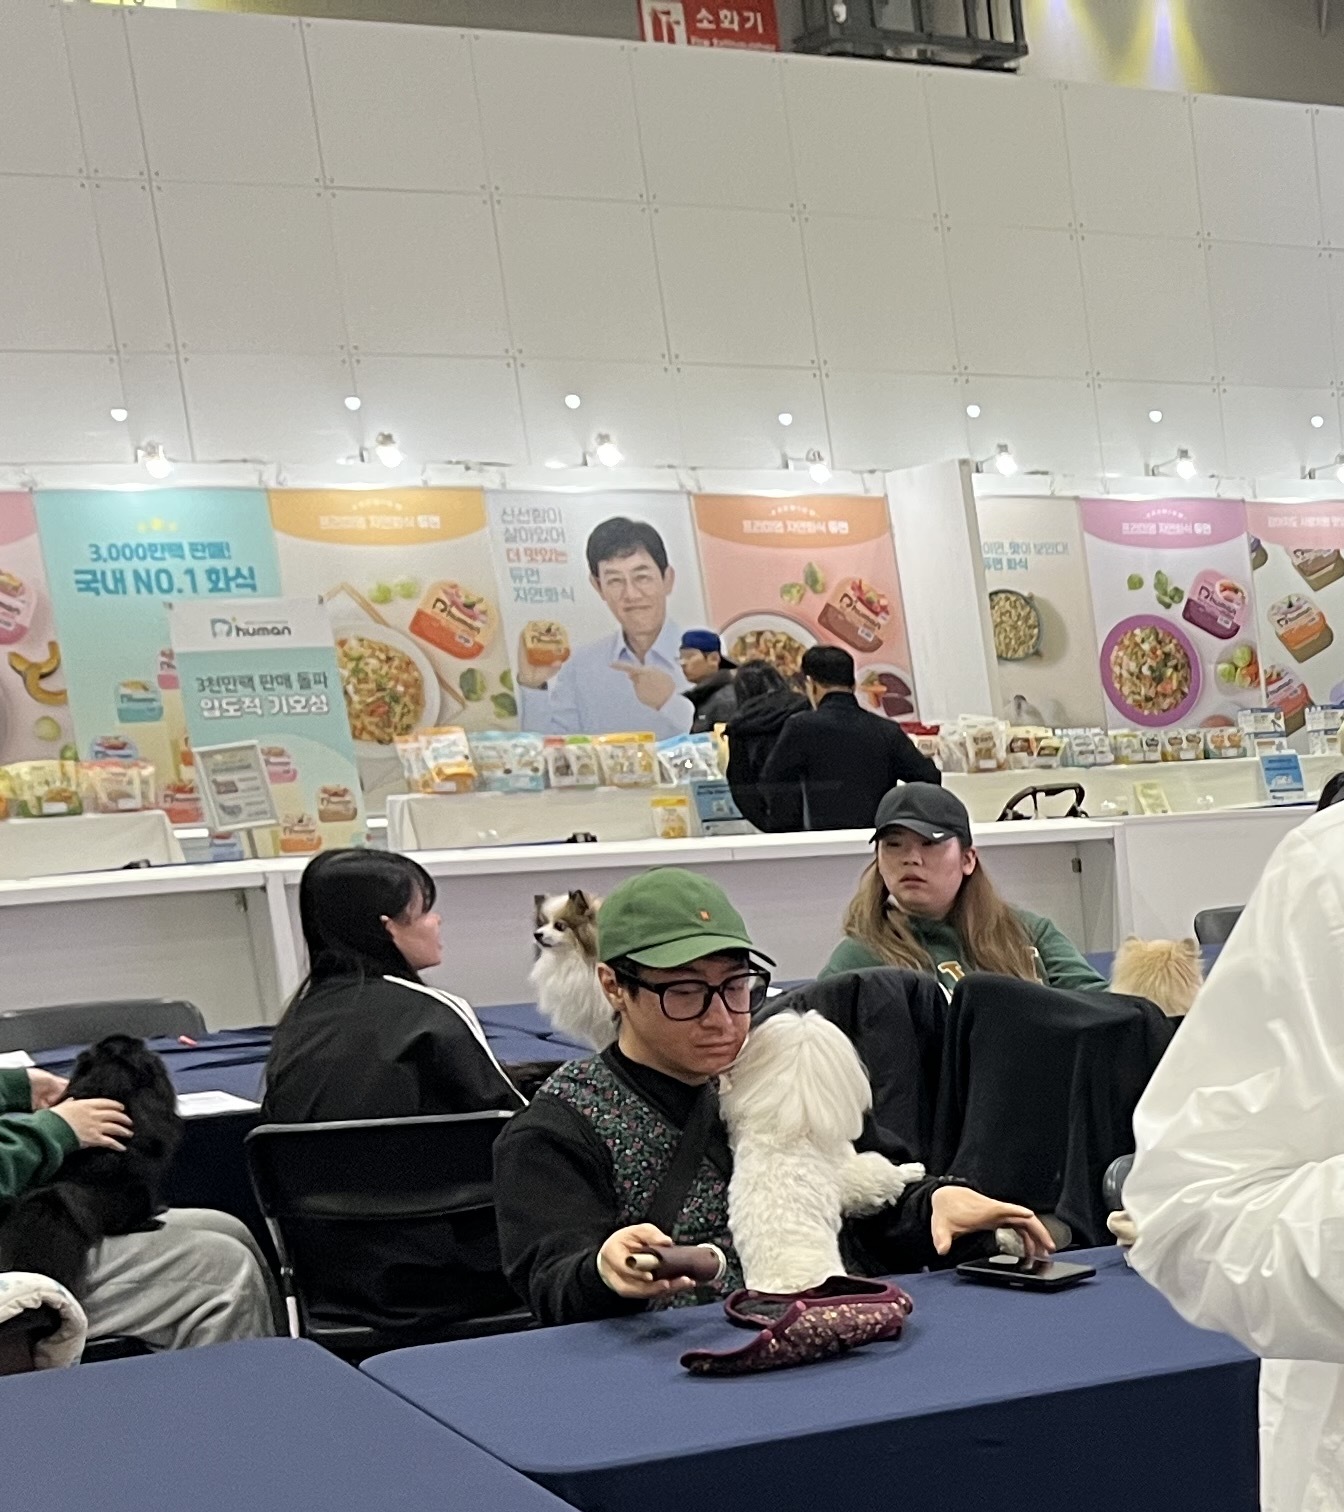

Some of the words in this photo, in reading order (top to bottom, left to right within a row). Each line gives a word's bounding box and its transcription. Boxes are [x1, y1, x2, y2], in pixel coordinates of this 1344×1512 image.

[695, 7, 764, 34] 소화기
[506, 548, 521, 563] 더
[74, 567, 128, 597] 국내
[132, 567, 198, 595] NO.1
[205, 566, 258, 593] 화식
[200, 696, 264, 719] 압도적
[268, 694, 330, 715] 기호성
